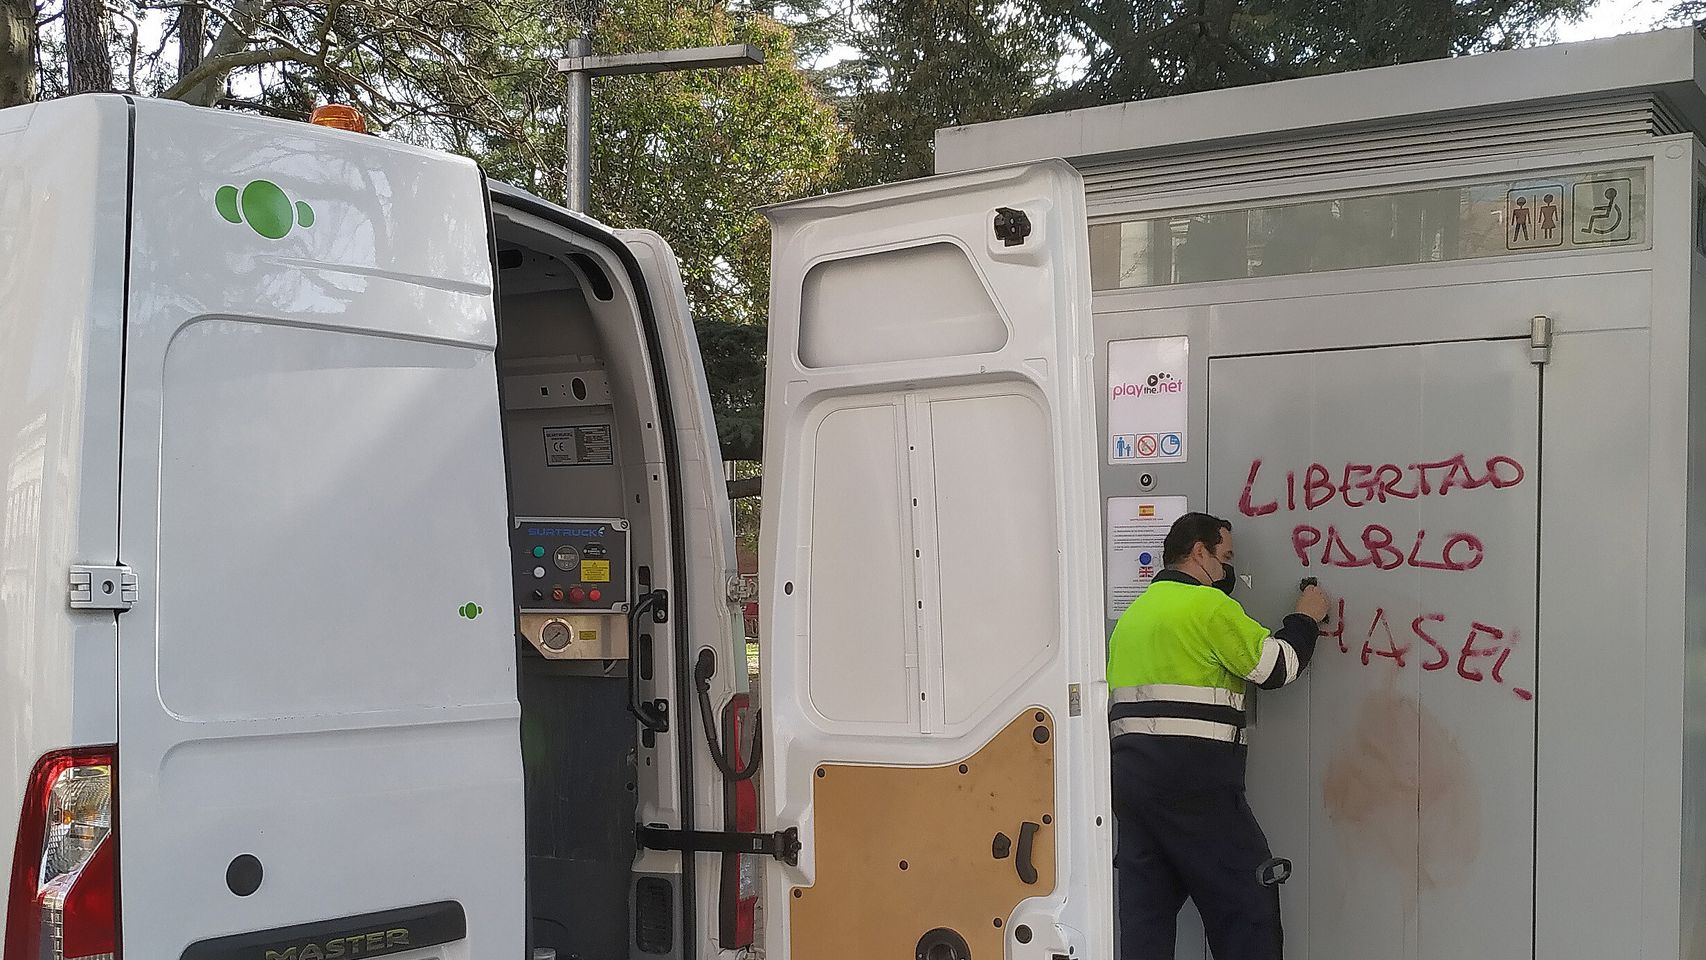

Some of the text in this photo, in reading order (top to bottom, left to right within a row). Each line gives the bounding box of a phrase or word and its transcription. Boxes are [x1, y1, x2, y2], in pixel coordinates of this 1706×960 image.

[1238, 454, 1525, 518] LIBERTAD
[1291, 523, 1485, 571] PABLO
[265, 928, 410, 960] MASTER
